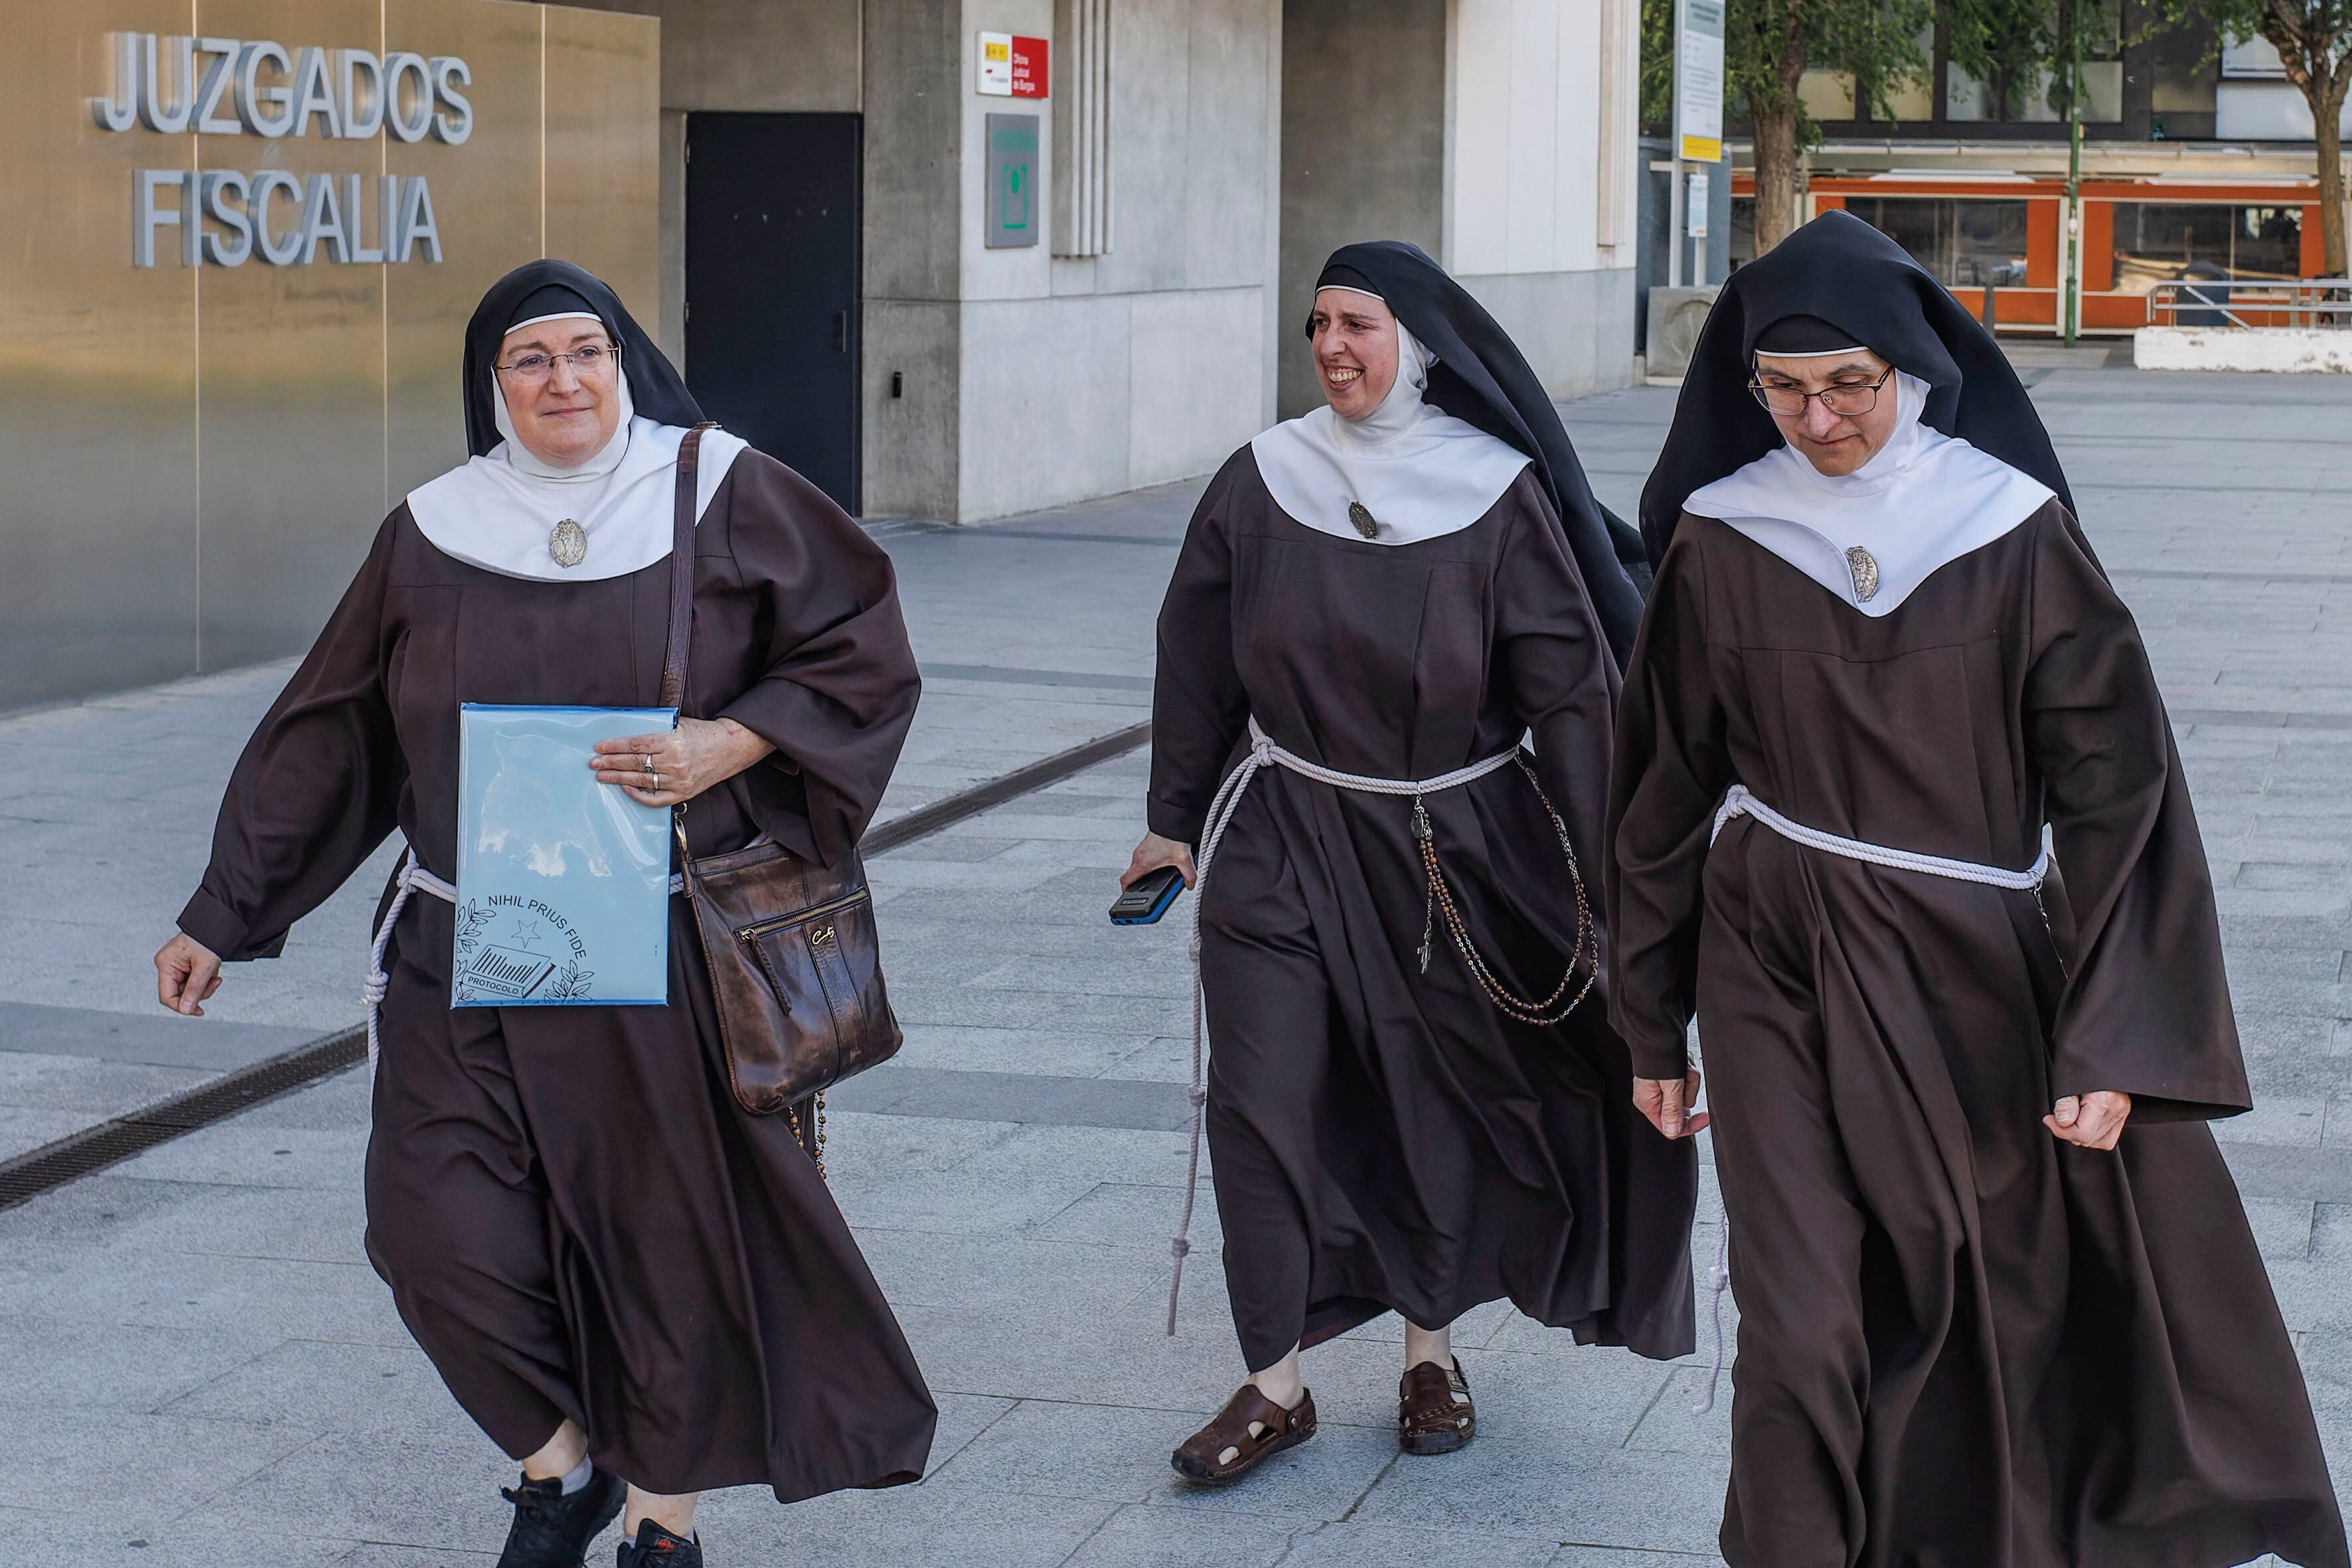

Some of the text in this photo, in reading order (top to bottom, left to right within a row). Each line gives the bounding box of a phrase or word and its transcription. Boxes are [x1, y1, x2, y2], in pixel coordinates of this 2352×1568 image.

[92, 31, 473, 146] JUZGADOS
[133, 169, 443, 268] FISCALIA
[489, 895, 587, 960] NIHIL PRIUS FIDE
[468, 976, 519, 994] PROTOCOLO
